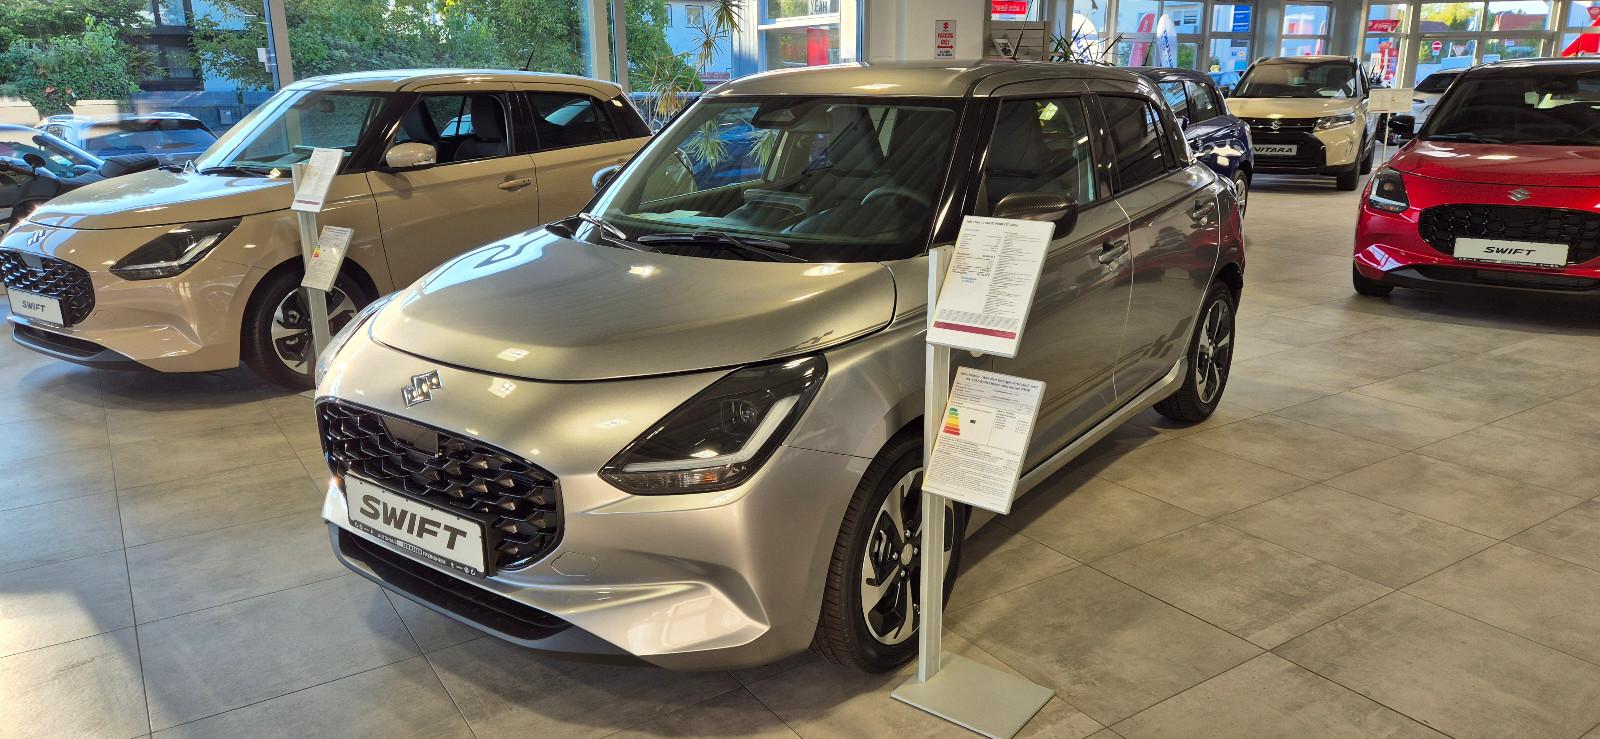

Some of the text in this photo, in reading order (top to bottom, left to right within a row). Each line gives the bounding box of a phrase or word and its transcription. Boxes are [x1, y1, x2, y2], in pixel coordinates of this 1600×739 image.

[1483, 246, 1536, 256] SWIFT
[22, 300, 46, 312] SWIFT
[360, 494, 468, 550] SWIFT
